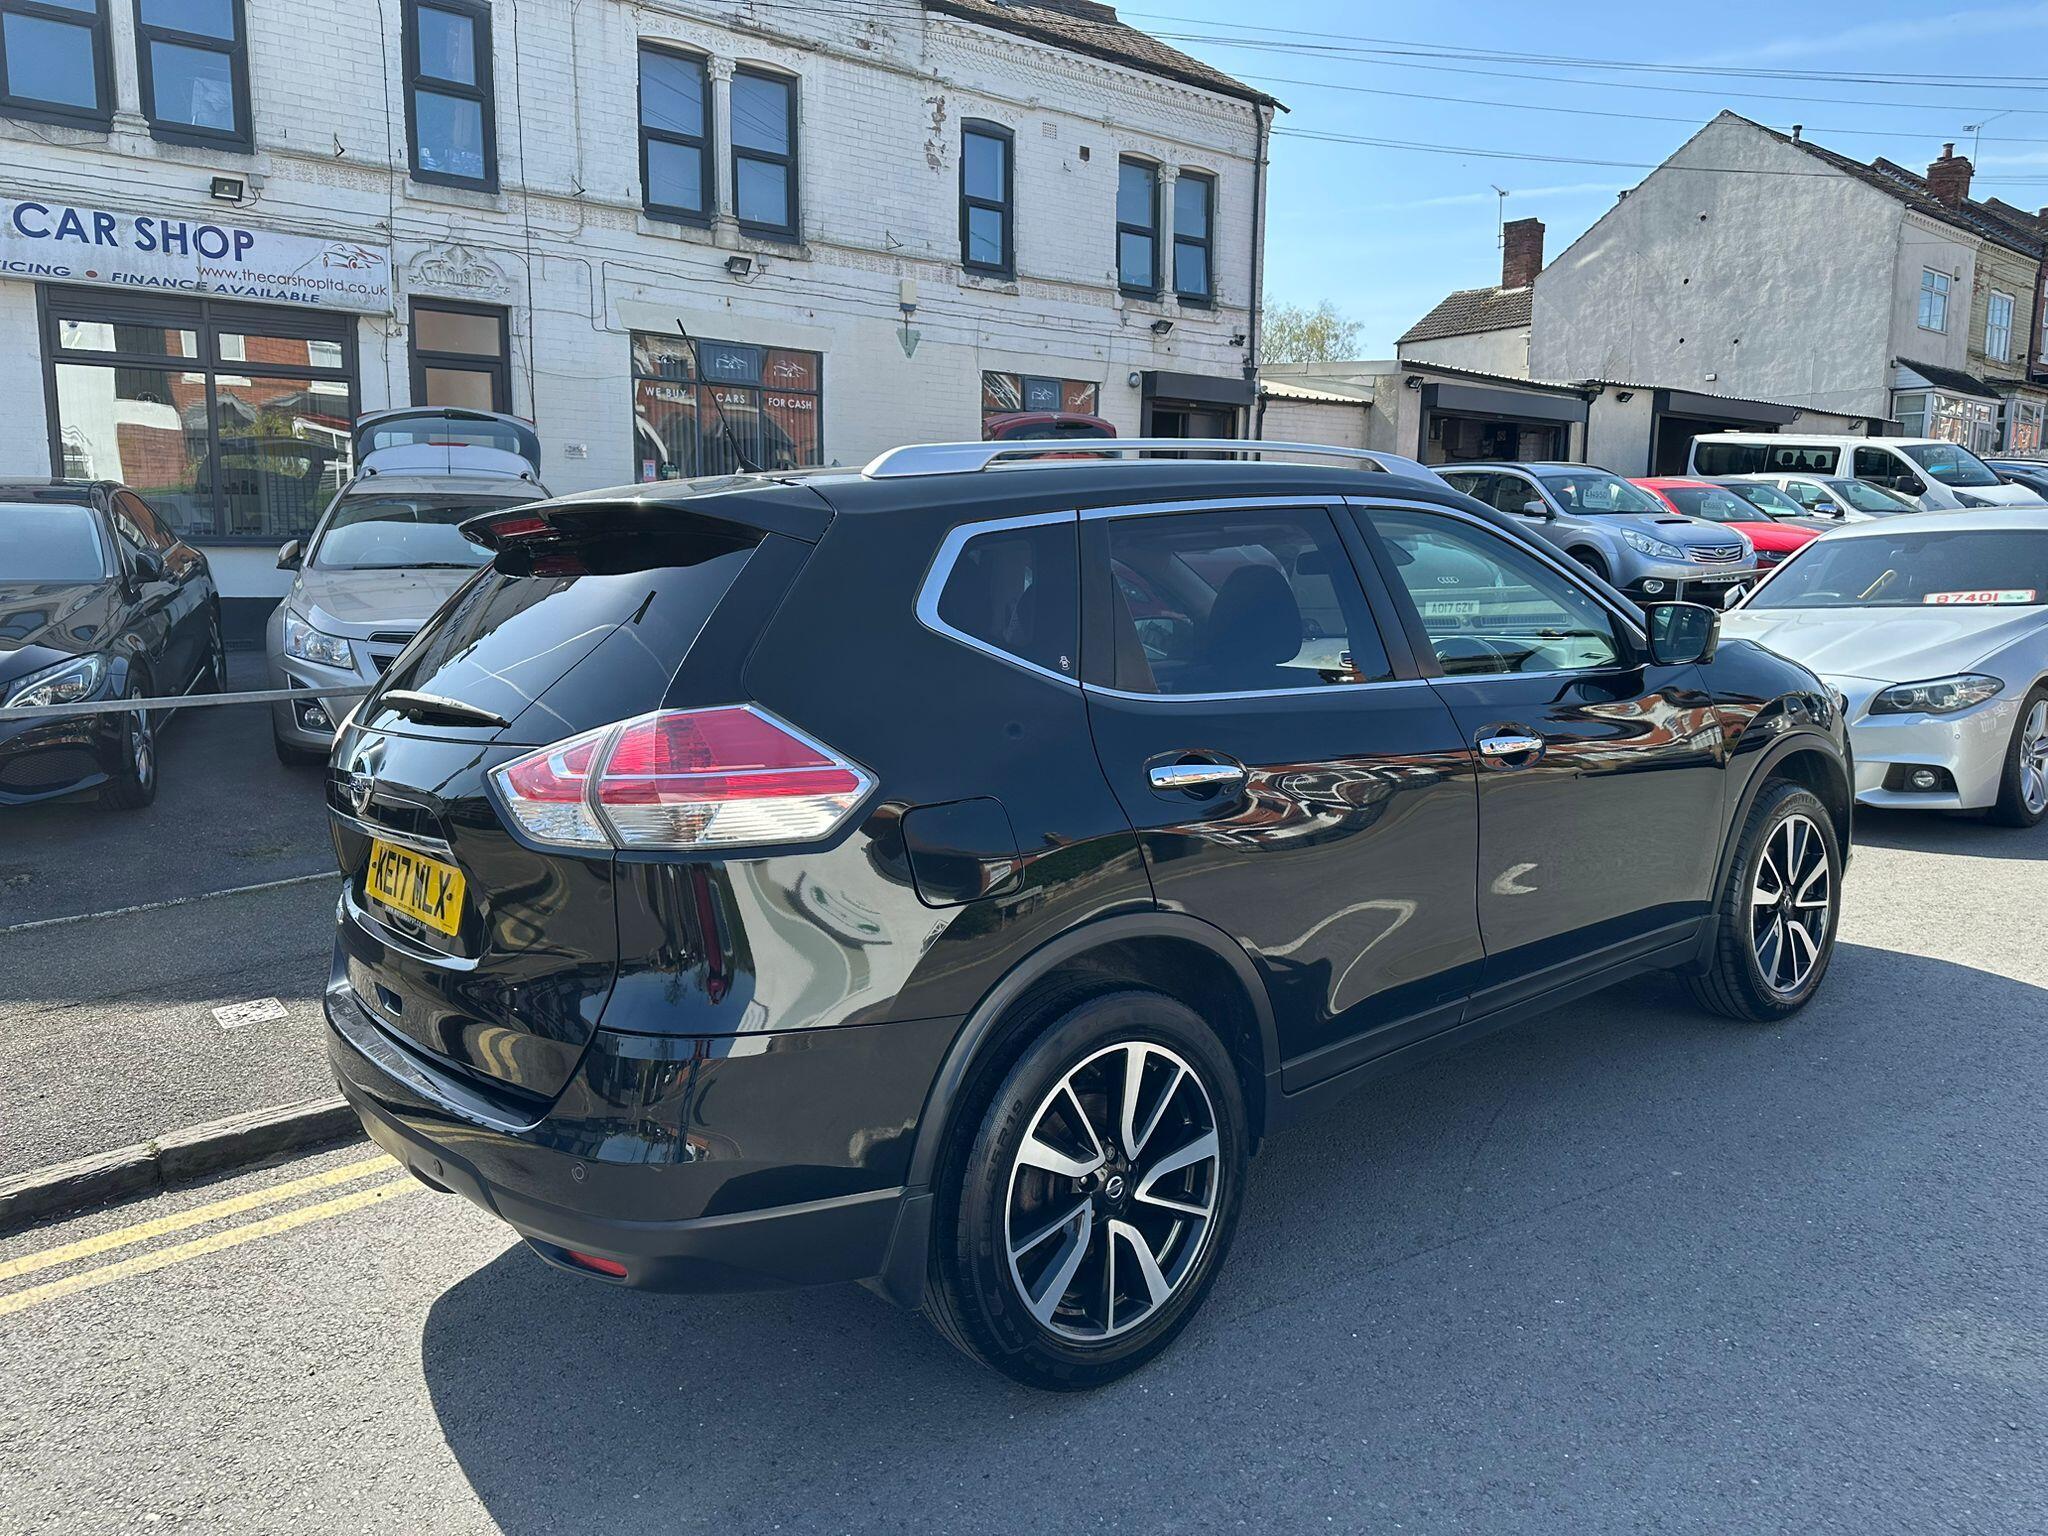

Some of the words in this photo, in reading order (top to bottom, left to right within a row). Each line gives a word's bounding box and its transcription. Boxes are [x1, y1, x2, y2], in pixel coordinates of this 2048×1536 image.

[13, 202, 118, 247] CAR
[134, 217, 254, 261] SHOP
[0, 260, 71, 276] ICING
[112, 272, 208, 291] FINANCE
[214, 284, 320, 303] AVAILABLE
[196, 266, 387, 297] www.thecarshopltd.co.uk
[645, 387, 661, 396] WE
[665, 388, 687, 398] BUY
[715, 393, 746, 404] CARS
[768, 397, 785, 408] FOR
[788, 399, 812, 410] CASH
[374, 847, 411, 899] KE17
